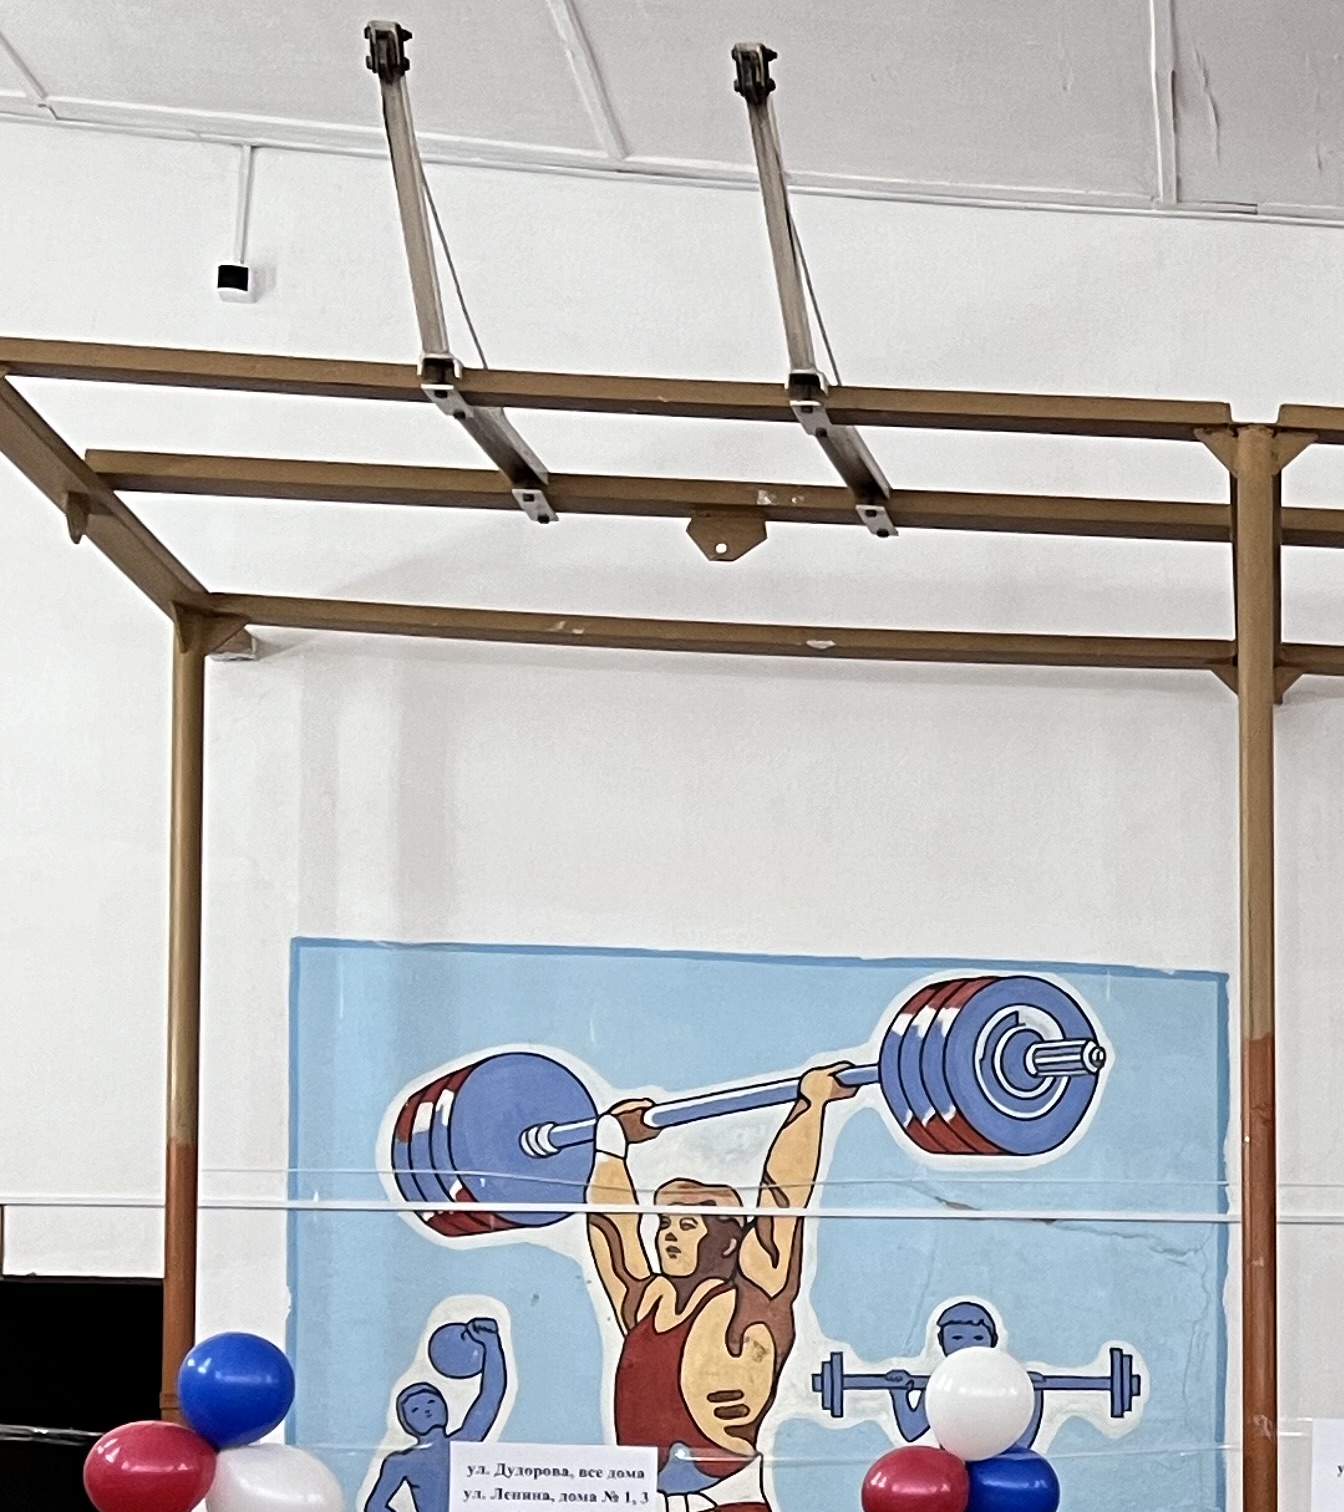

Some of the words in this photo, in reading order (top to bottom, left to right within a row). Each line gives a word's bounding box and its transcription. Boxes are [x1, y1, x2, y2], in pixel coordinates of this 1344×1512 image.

[467, 1464, 490, 1478] ул.
[493, 1463, 574, 1480] Дудорова,
[579, 1468, 603, 1478] все
[607, 1468, 645, 1479] дома
[463, 1489, 486, 1502] ул.
[490, 1488, 555, 1502] Ленина,
[558, 1491, 597, 1503] дома
[601, 1490, 619, 1503] №
[640, 1491, 649, 1504] 3
